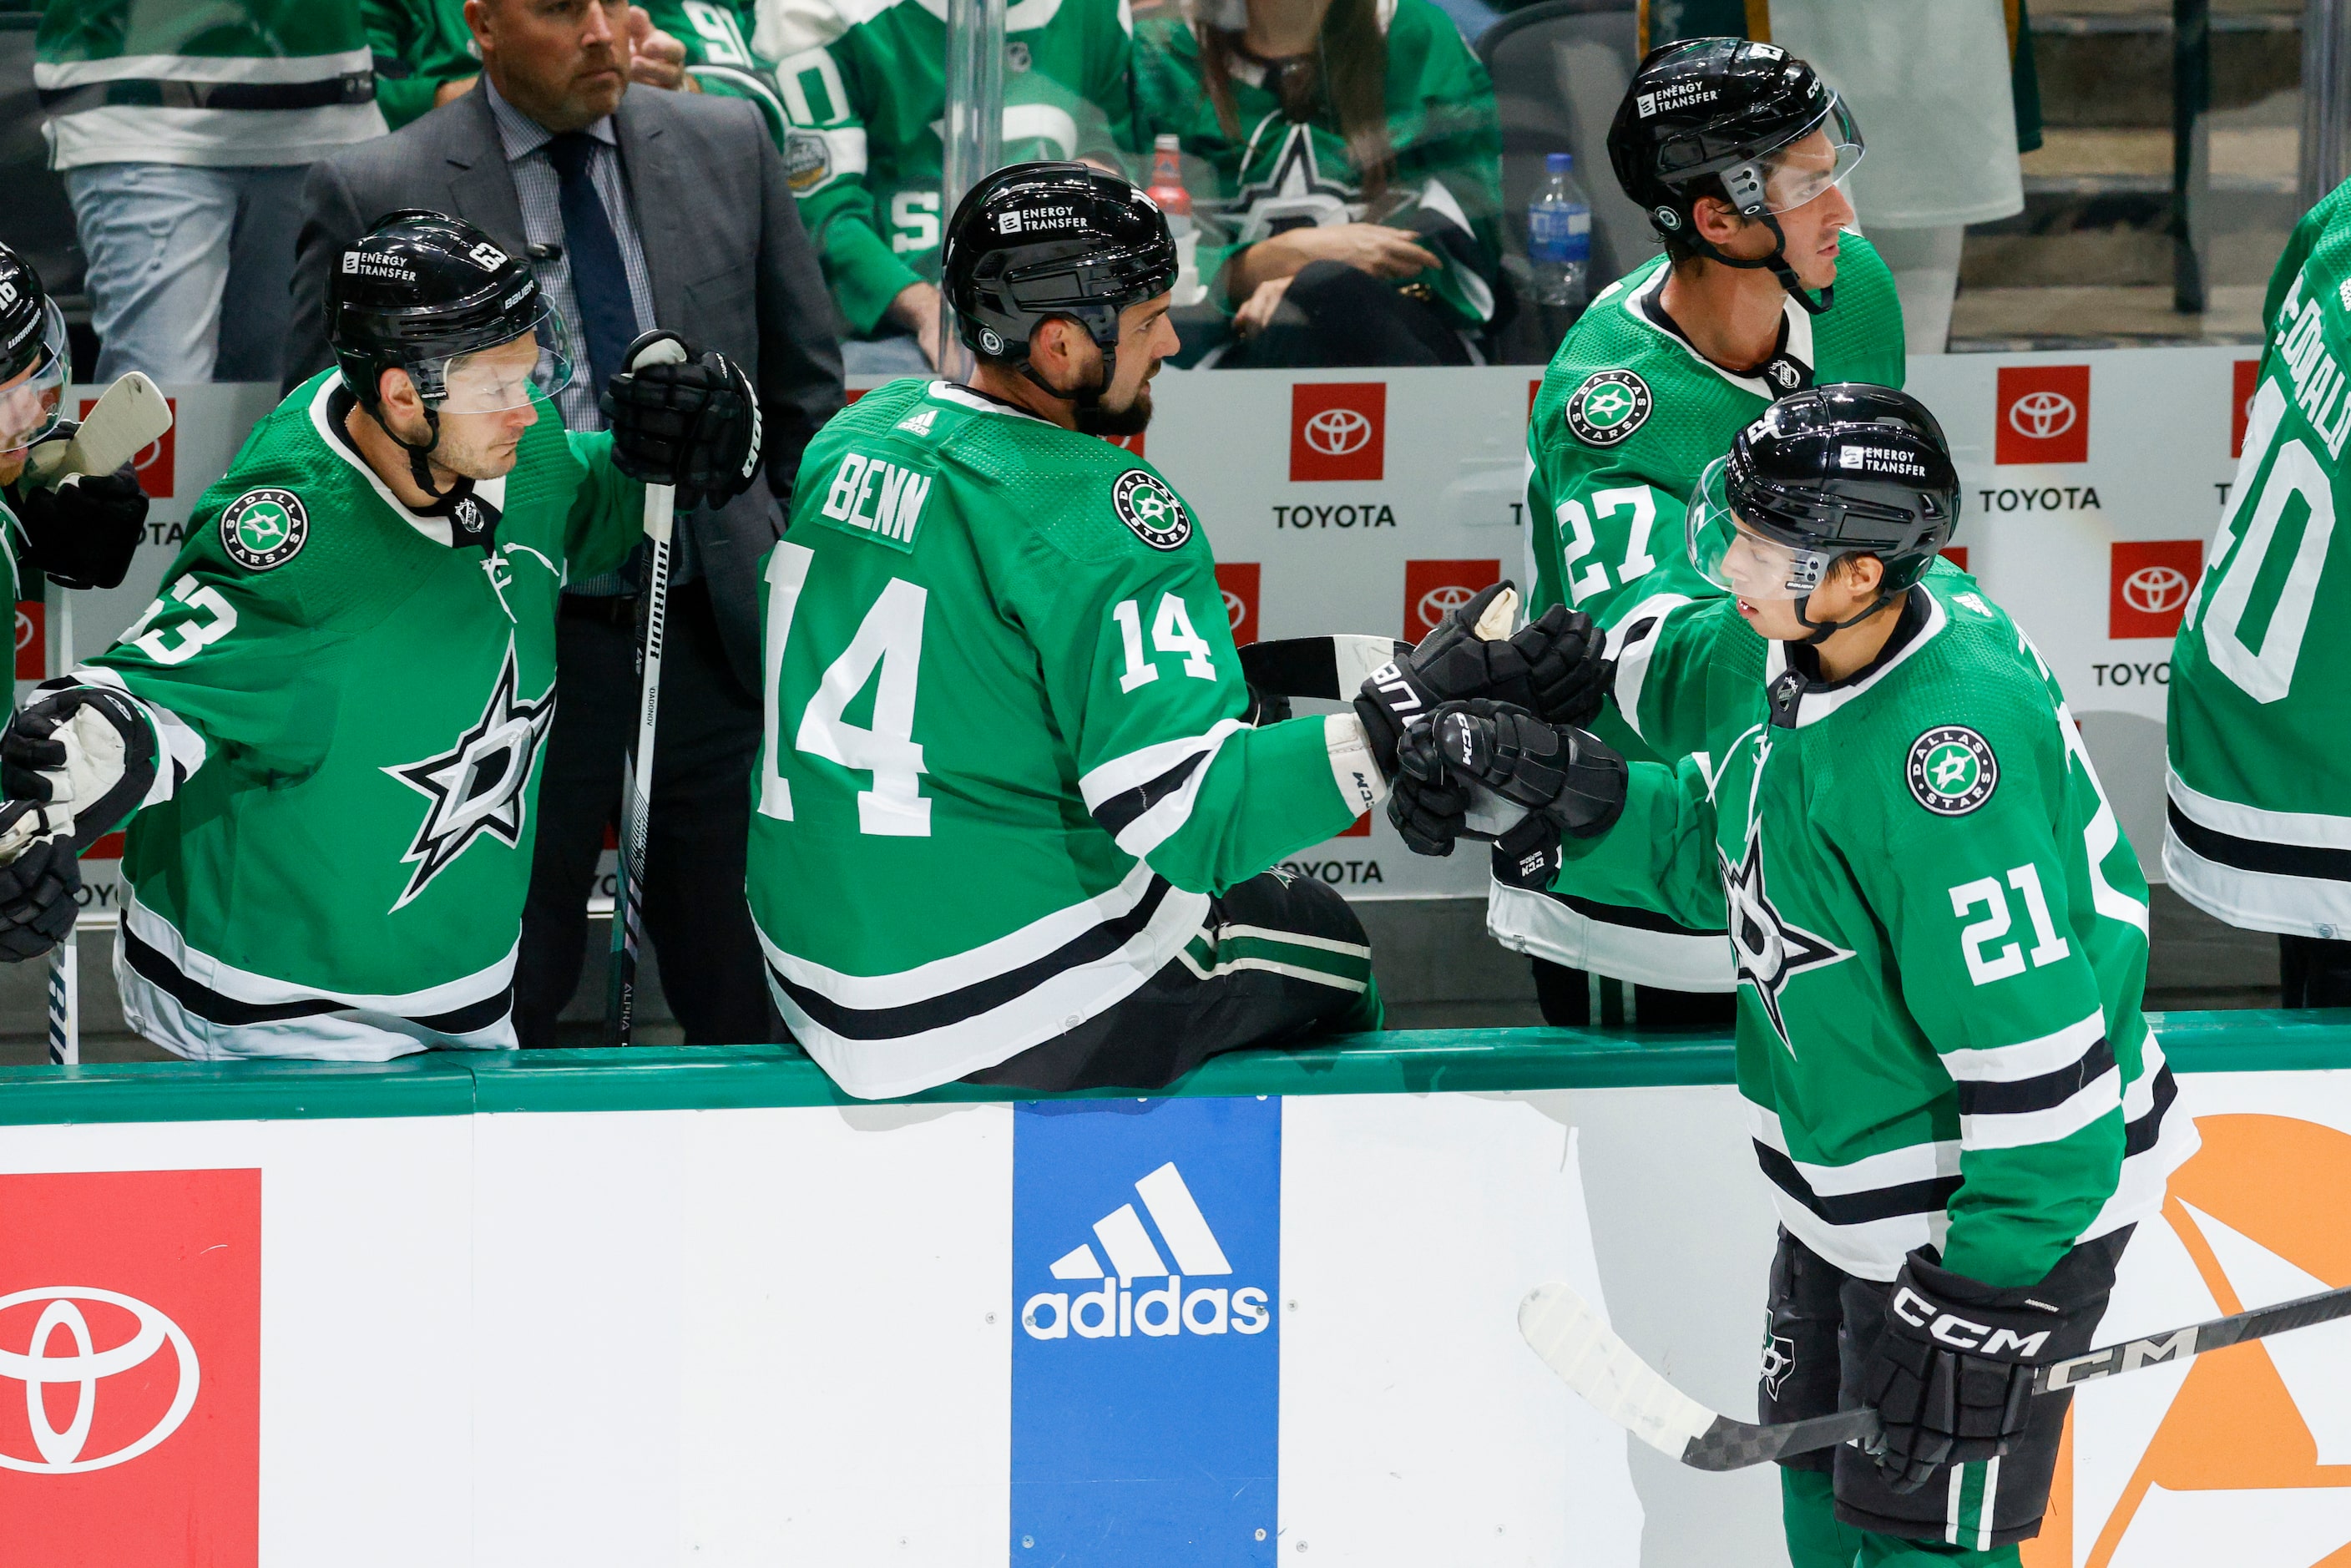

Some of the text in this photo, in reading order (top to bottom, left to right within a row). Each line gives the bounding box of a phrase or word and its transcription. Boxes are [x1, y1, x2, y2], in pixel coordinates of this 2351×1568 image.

[1656, 81, 1703, 101] ENERGY
[1657, 90, 1718, 113] TRANSFER
[1023, 206, 1074, 220] ENERGY
[1024, 218, 1088, 231] TRANSFER
[360, 265, 417, 281] TRANSFER
[361, 253, 407, 267] ENERGY
[504, 279, 534, 310] BAUER
[8, 307, 42, 350] WARRIOR
[1579, 374, 1647, 407] DALLAS
[1572, 412, 1633, 440] STARS
[1866, 447, 1915, 463] ENERGY
[1866, 459, 1926, 478] TRANSFER
[822, 453, 932, 544] BENN
[1119, 475, 1181, 508] DALLAS
[1979, 487, 2101, 513] TOYOTA
[244, 493, 301, 544] DALLAS
[1130, 517, 1186, 544] STARS
[1272, 504, 1397, 529] TOYOTA
[225, 518, 276, 564] STARS
[1555, 484, 1656, 608] 27
[1112, 592, 1216, 694] 14
[757, 541, 932, 837] 14
[1456, 712, 1472, 766] CCM
[1913, 732, 1984, 776] DALLAS
[1926, 772, 1991, 809] STARS
[1949, 862, 2070, 987] 21
[622, 983, 633, 1031] ALPHA
[1022, 1275, 1270, 1340] adidas
[1893, 1287, 2051, 1357] CCM
[2032, 1325, 2199, 1395] CM
